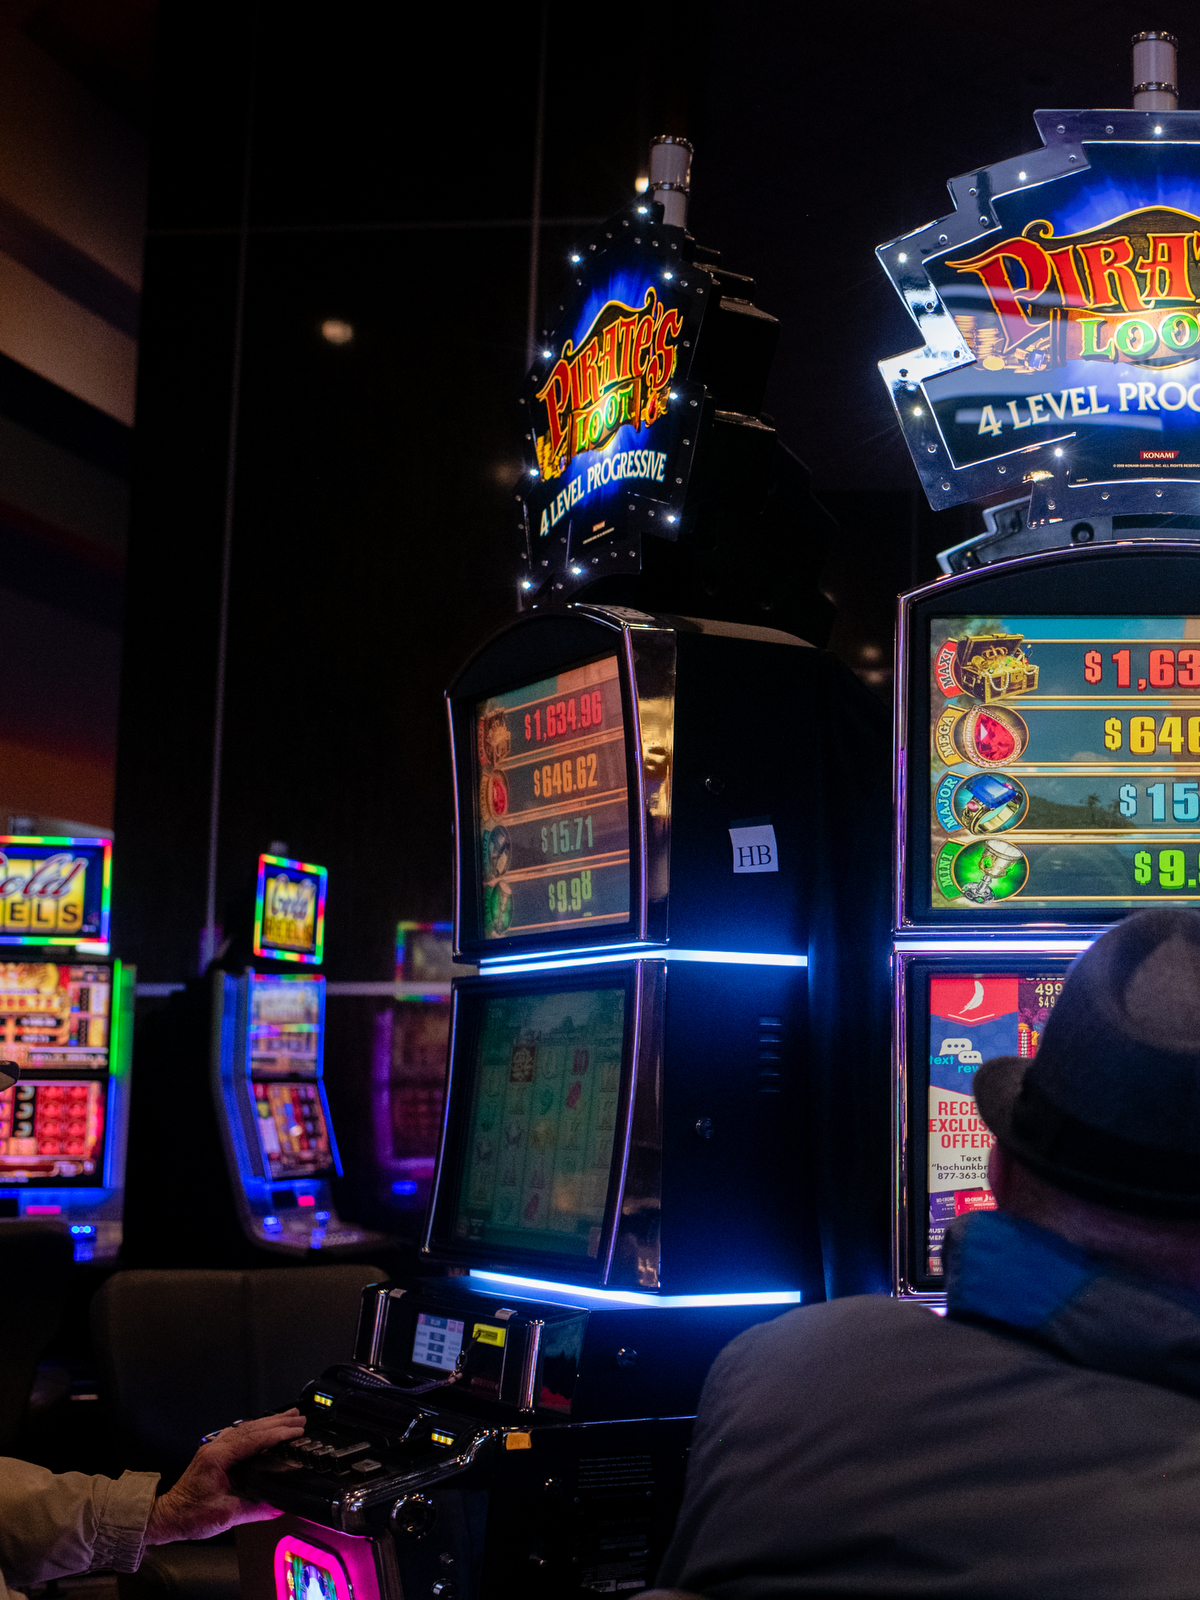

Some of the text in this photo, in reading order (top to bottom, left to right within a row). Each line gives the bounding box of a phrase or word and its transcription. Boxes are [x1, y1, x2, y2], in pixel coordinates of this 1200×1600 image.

[536, 302, 683, 458] PIRATE'S
[576, 384, 634, 452] LOOT
[978, 405, 1003, 437] 4
[1007, 385, 1109, 431] LEVEL
[540, 450, 667, 537] 4 LEVEL PROGRESSIVE
[943, 649, 956, 690] MAXI
[524, 690, 602, 742] $1,634.96
[942, 715, 955, 757] MEGA
[533, 753, 598, 798] $646.62
[946, 777, 959, 829] MAJOR
[541, 816, 594, 855] $15.71
[737, 844, 772, 867] HB
[941, 853, 954, 889] MINI
[930, 1055, 954, 1065] text
